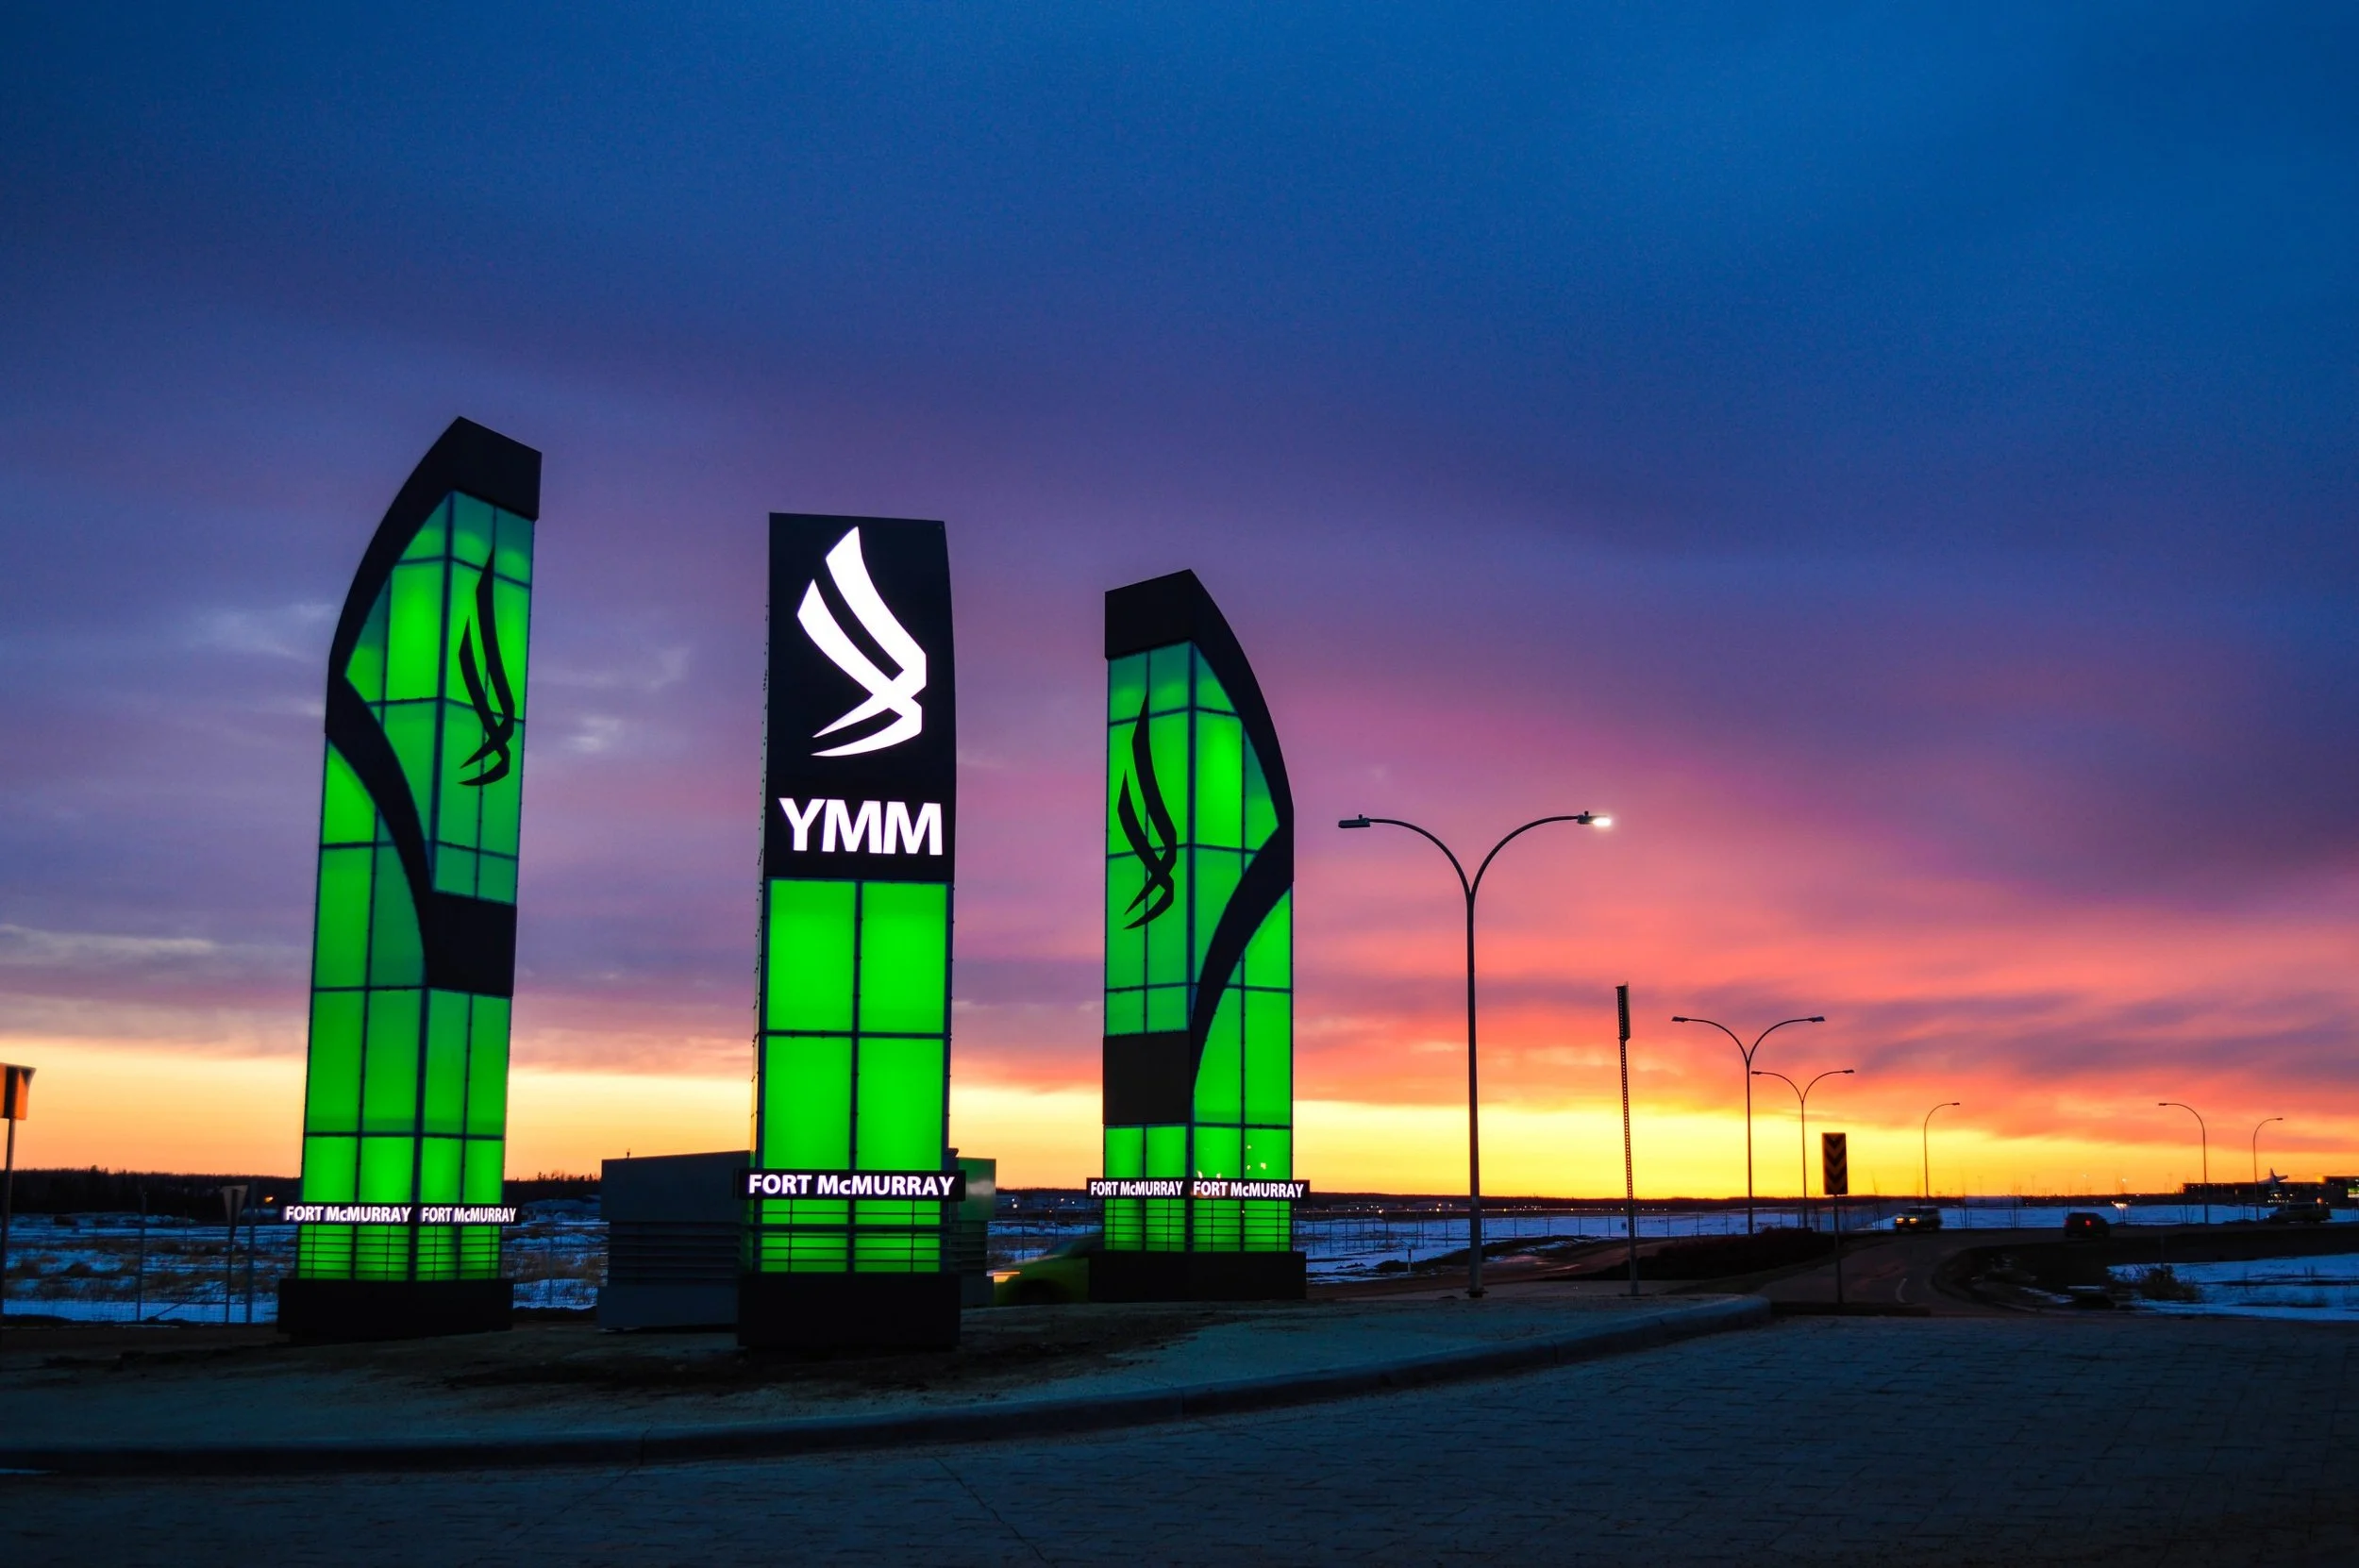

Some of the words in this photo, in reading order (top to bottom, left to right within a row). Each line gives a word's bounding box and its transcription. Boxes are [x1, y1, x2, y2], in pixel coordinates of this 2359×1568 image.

[779, 798, 942, 855] YMM
[749, 1175, 811, 1194] FORT
[817, 1176, 954, 1195] McMURRAY
[1091, 1181, 1118, 1195] FORT
[1120, 1181, 1183, 1196] McMURRAY
[1194, 1181, 1228, 1196] FORT
[1230, 1182, 1304, 1198] McMURRAY
[285, 1206, 324, 1222] FORT
[326, 1206, 411, 1222] McMURRAY
[421, 1207, 452, 1222] FORT
[454, 1208, 516, 1223] McMURRAY
